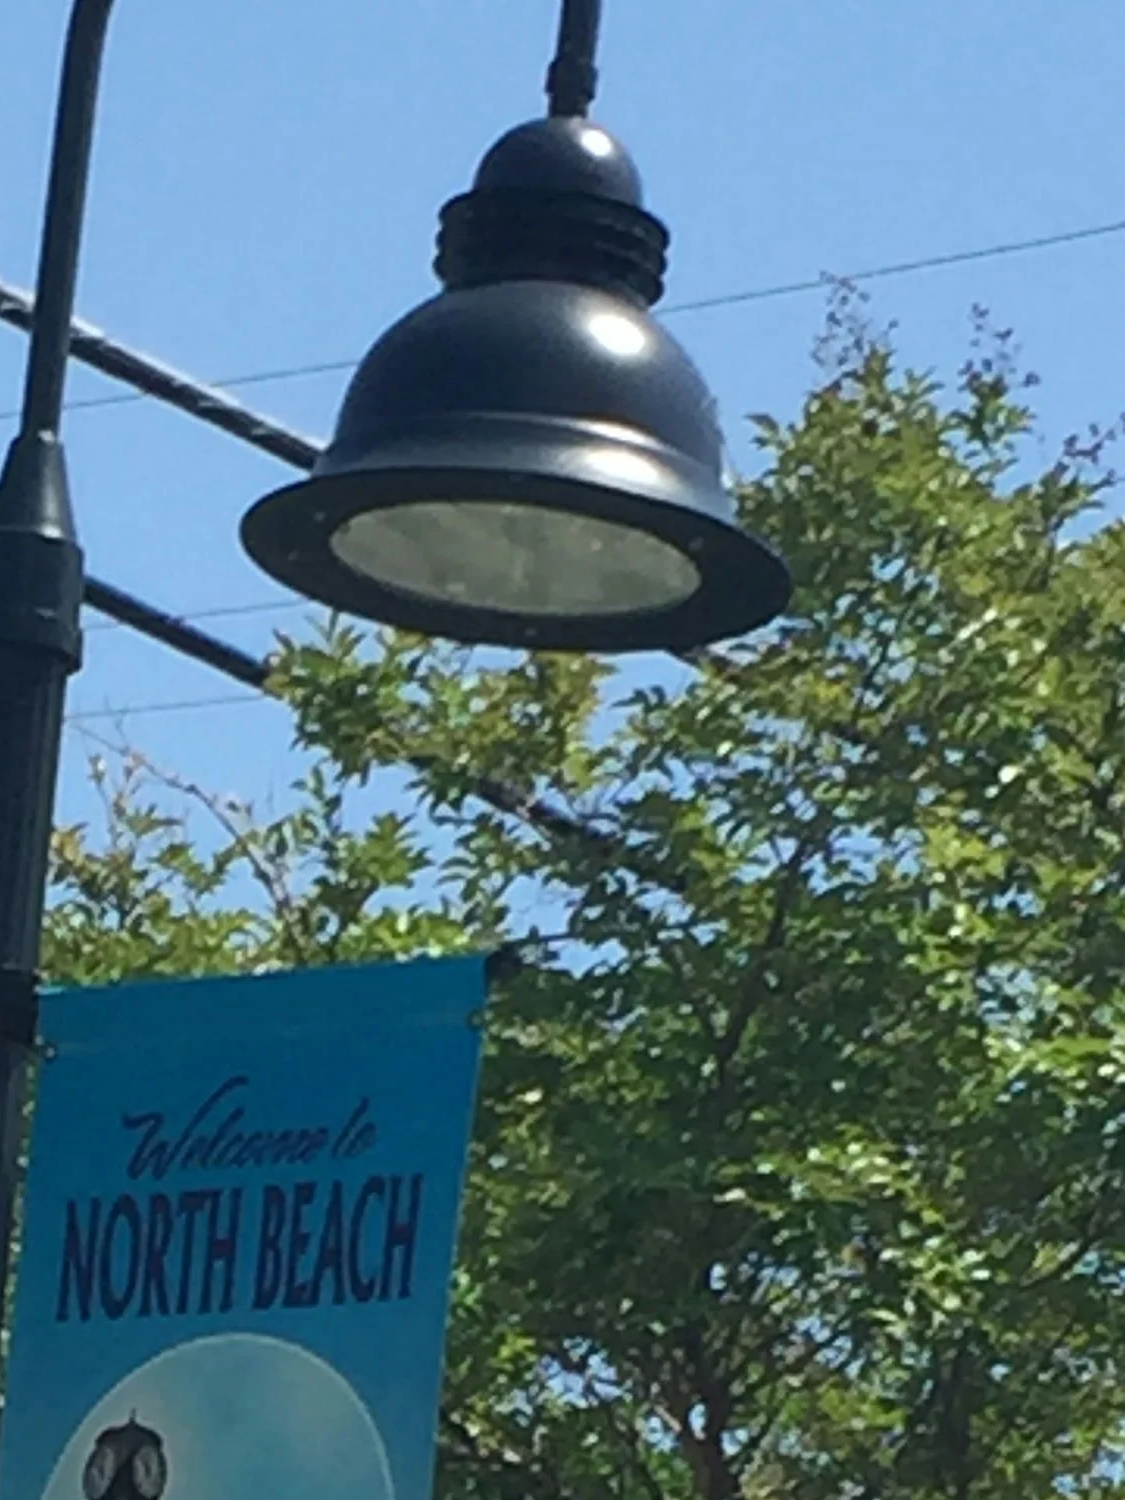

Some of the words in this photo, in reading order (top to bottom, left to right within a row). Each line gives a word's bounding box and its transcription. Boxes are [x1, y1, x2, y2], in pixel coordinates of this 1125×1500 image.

[122, 1075, 329, 1181] Welcome
[331, 1096, 378, 1159] to
[56, 1187, 244, 1323] NORTH
[251, 1173, 424, 1311] BEACH
